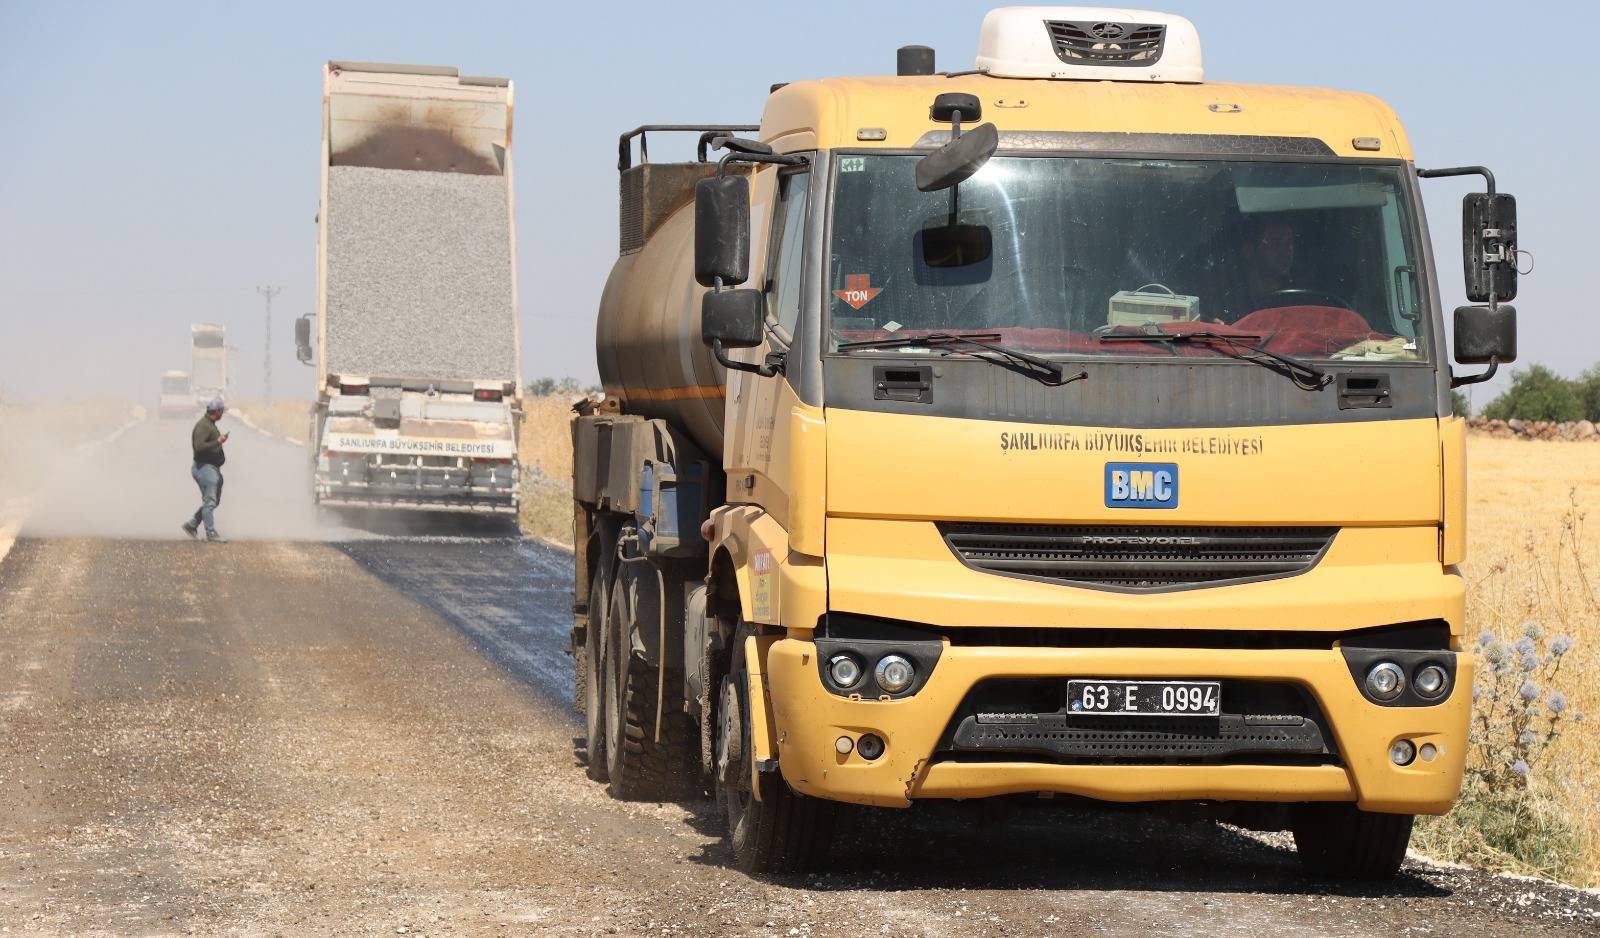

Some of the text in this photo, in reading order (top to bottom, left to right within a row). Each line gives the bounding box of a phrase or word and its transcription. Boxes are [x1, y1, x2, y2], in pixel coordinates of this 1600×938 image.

[846, 275, 869, 290] 25
[845, 290, 868, 301] TON
[1000, 432, 1080, 455] ŞANLIURFA
[1112, 470, 1172, 502] BMC
[1082, 536, 1201, 545] PROFESYONEL
[1082, 685, 1216, 712] 63 E 0994
